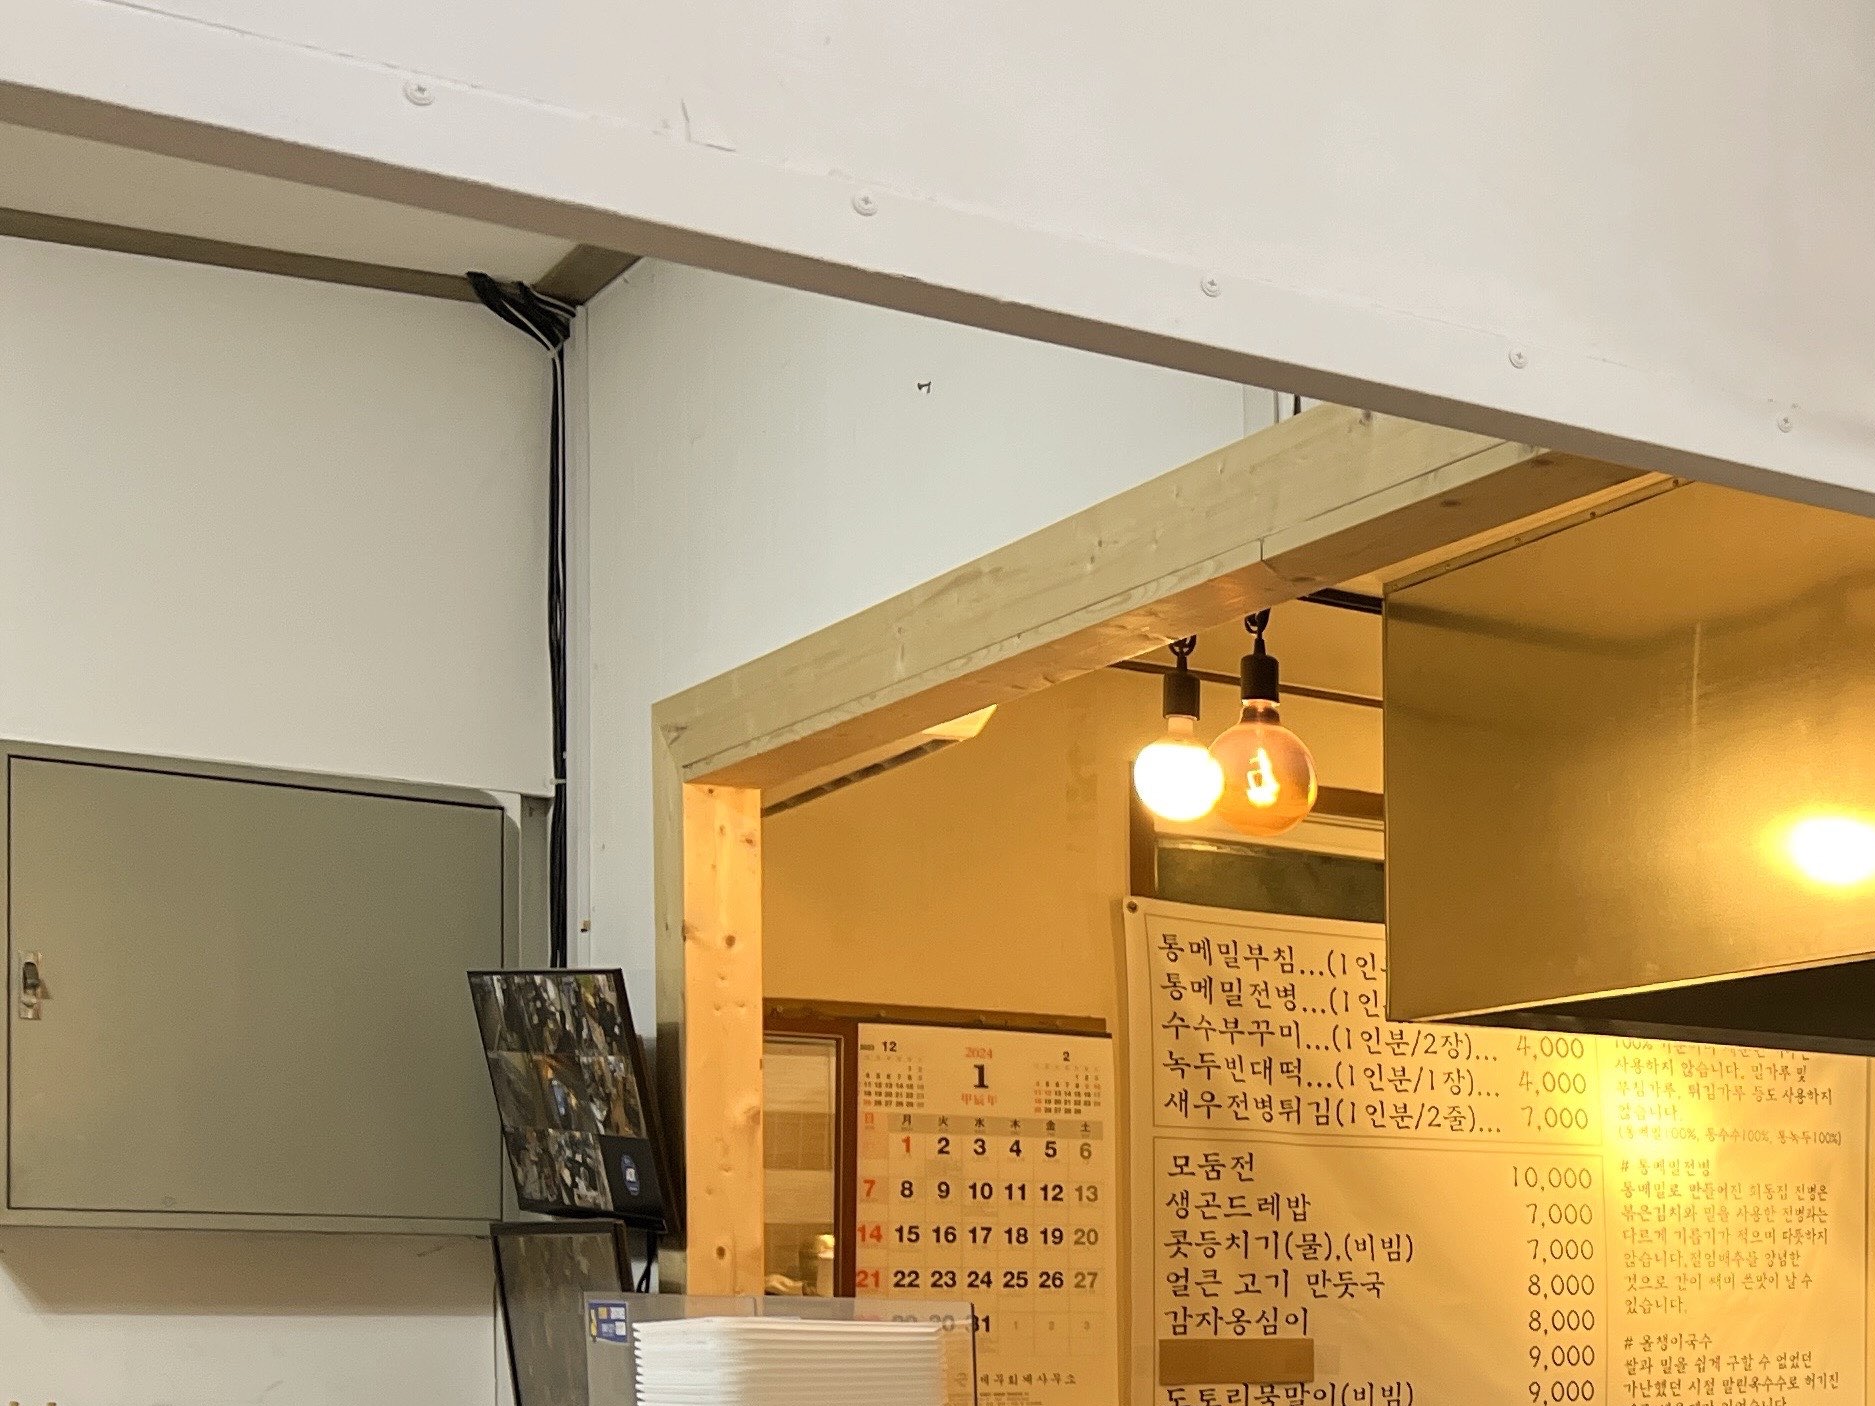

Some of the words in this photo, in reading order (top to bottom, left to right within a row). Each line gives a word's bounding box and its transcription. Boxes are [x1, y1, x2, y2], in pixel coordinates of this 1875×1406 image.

[1158, 933, 1387, 981] 통메밀부침...(1인
[1160, 972, 1387, 1018] 통메밀전병...(1인
[1516, 1034, 1585, 1061] 4,000
[973, 1064, 989, 1089] 1
[1518, 1069, 1587, 1097] 4,000
[1521, 1106, 1589, 1132] 7,000
[901, 1136, 911, 1154] 1
[937, 1136, 950, 1154] 2
[973, 1138, 986, 1155] 3
[1009, 1139, 1022, 1157] 4
[1044, 1140, 1057, 1159] 5
[1079, 1142, 1092, 1160] 6
[1167, 1152, 1256, 1183] 모둠전
[1512, 1166, 1593, 1192] 10,000
[864, 1178, 876, 1198] 7
[900, 1180, 914, 1198] 8
[937, 1181, 951, 1199] 9
[968, 1182, 993, 1200] 10
[1004, 1183, 1027, 1202] 11
[1040, 1184, 1064, 1202] 12
[1074, 1185, 1099, 1203] 13
[1165, 1191, 1311, 1223] 생곤드레밥
[1525, 1202, 1594, 1228] 7,000
[857, 1225, 883, 1243] 14
[895, 1225, 920, 1243] 15
[931, 1226, 957, 1244] 16
[967, 1226, 993, 1244] 17
[1004, 1227, 1029, 1245] 18
[1040, 1228, 1064, 1245] 19
[1074, 1228, 1099, 1246] 20
[1526, 1238, 1595, 1264] 7,000
[856, 1270, 881, 1288] 21
[893, 1270, 920, 1288] 22
[930, 1270, 957, 1289] 23
[967, 1271, 992, 1288] 24
[1002, 1271, 1029, 1289] 25
[1038, 1271, 1064, 1289] 26
[1074, 1272, 1098, 1289] 27
[1165, 1268, 1224, 1299] 얼큰
[1234, 1269, 1290, 1298] 고기
[1306, 1271, 1386, 1300] 만둣국
[1527, 1274, 1595, 1301] 8,000
[1164, 1306, 1309, 1338] 감자옹심이
[1527, 1310, 1596, 1336] 8,000
[1527, 1345, 1596, 1371] 9,000
[1527, 1380, 1595, 1406] 9,000
